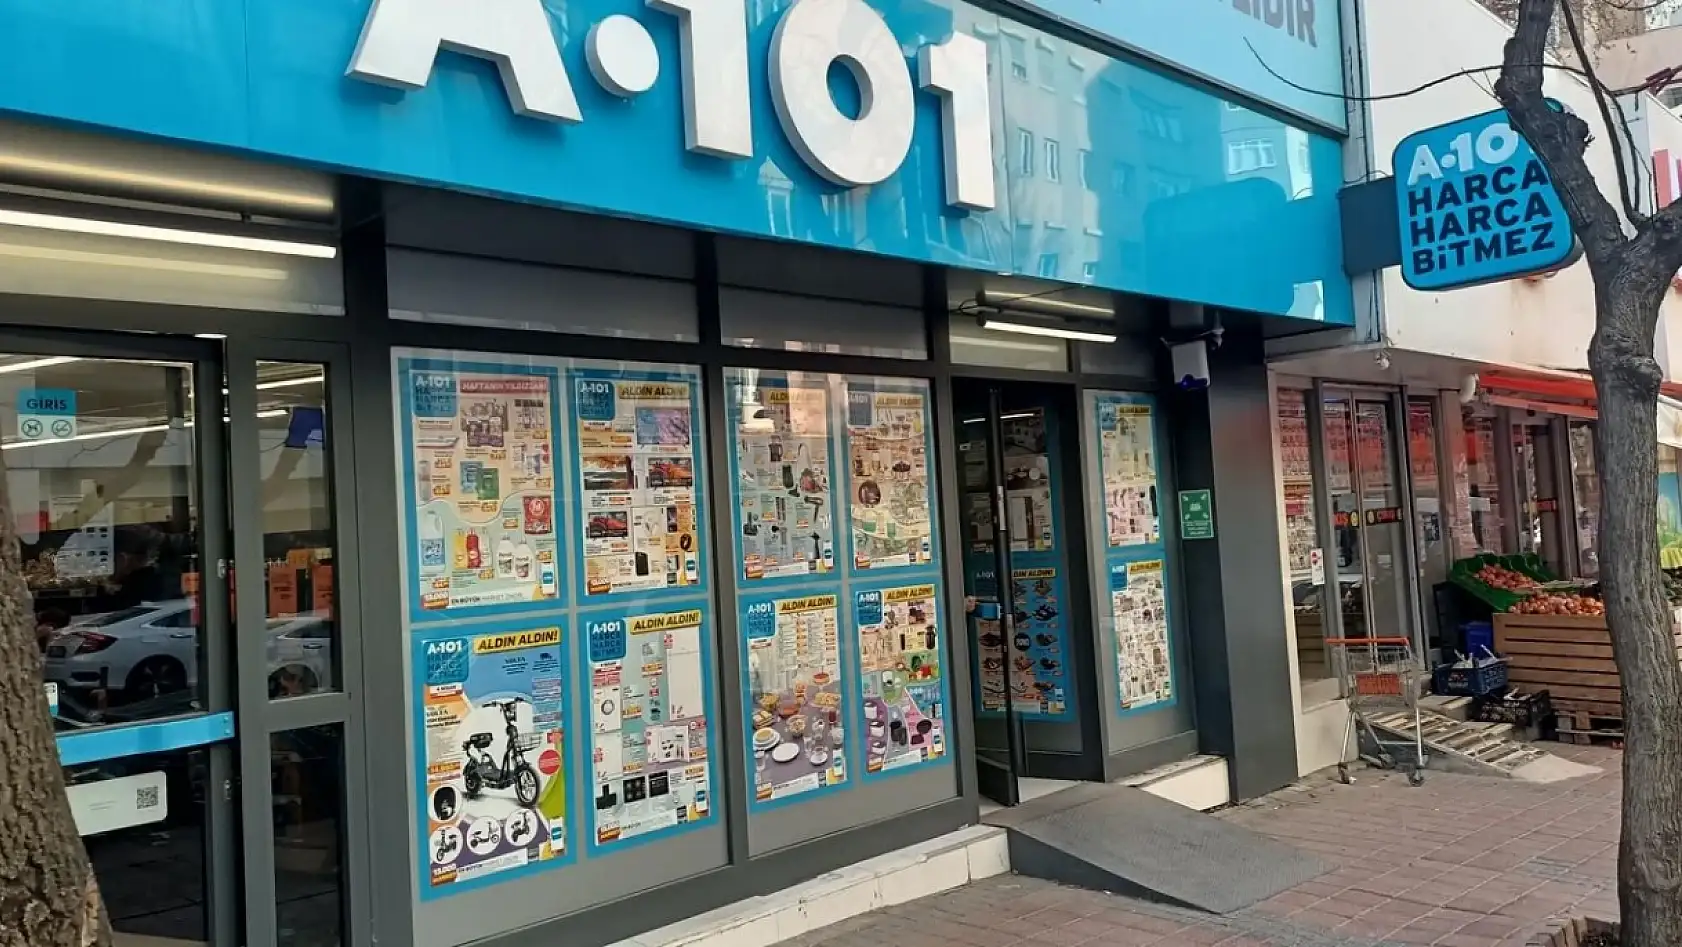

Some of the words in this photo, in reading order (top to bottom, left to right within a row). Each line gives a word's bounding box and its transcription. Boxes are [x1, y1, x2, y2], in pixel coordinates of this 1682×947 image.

[1408, 159, 1550, 217] HARCA
[1410, 190, 1553, 248] HARCA
[477, 636, 517, 651] ALDIN
[519, 630, 558, 645] ALDIN!
[634, 618, 664, 631] ALDIN
